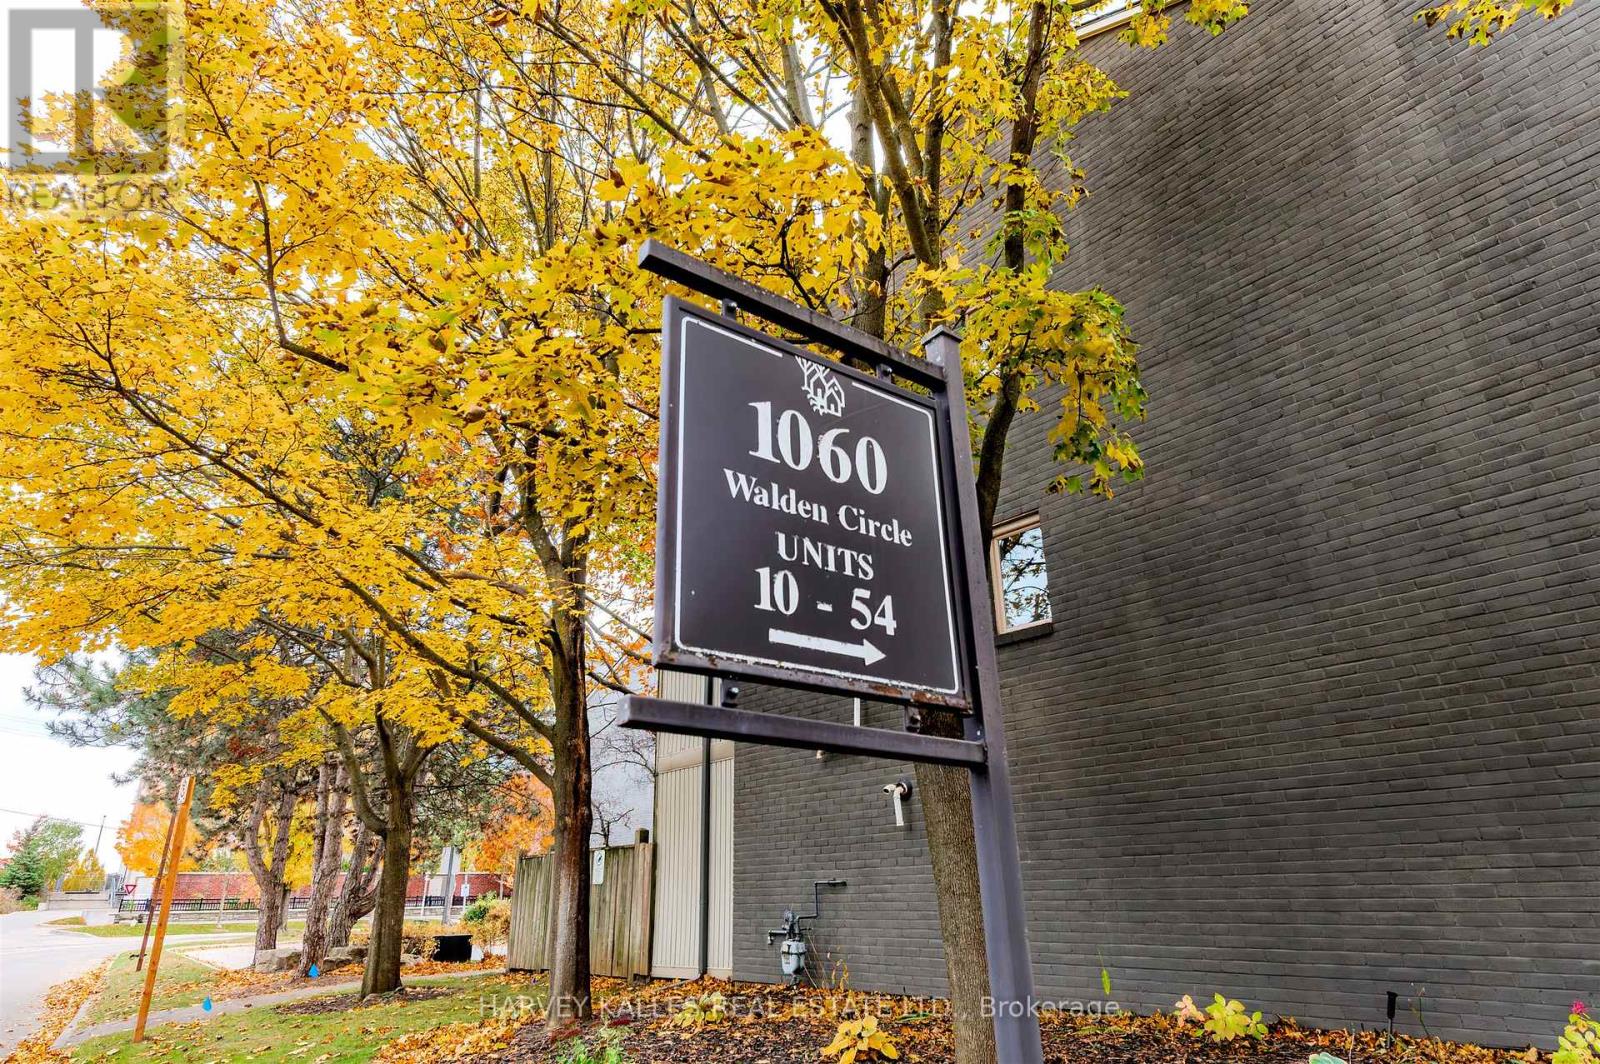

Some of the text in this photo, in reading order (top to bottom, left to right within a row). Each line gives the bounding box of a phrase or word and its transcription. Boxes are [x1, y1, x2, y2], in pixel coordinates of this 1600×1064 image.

[748, 400, 888, 495] 1060
[723, 468, 913, 547] Walden Circle
[775, 531, 875, 581] UNITS
[753, 566, 897, 636] 10 - 54
